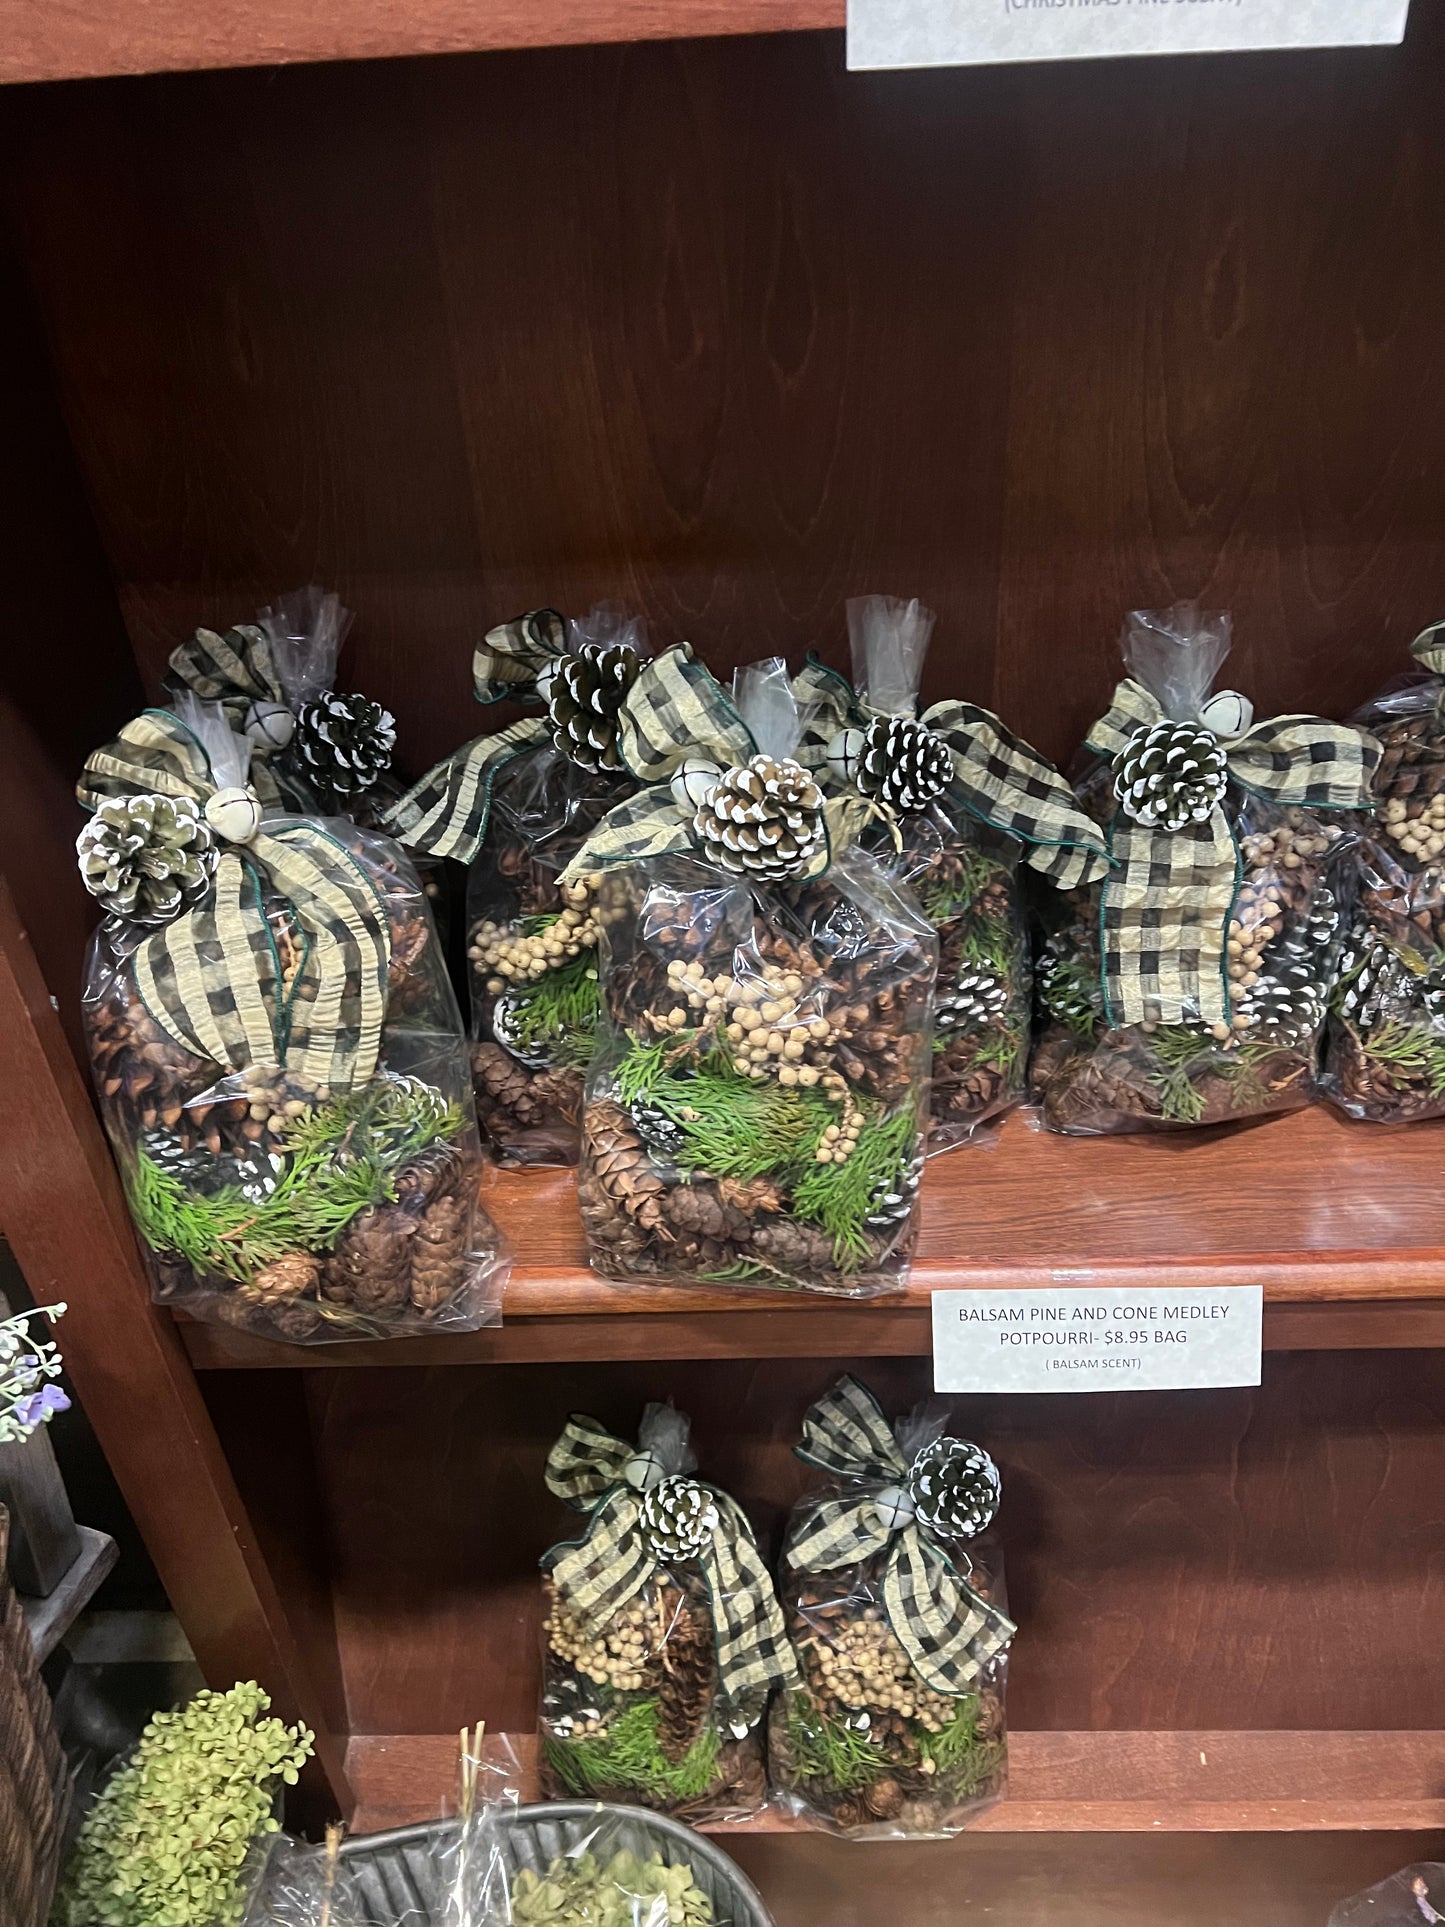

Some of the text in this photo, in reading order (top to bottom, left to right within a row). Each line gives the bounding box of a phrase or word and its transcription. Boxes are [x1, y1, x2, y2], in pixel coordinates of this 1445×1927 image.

[959, 1305, 1230, 1322] BALSAM PINE AND CONE MEDLEY
[1000, 1330, 1187, 1346] POTPOURRI- $8.95 BAG
[1101, 1358, 1142, 1371] SCENT)
